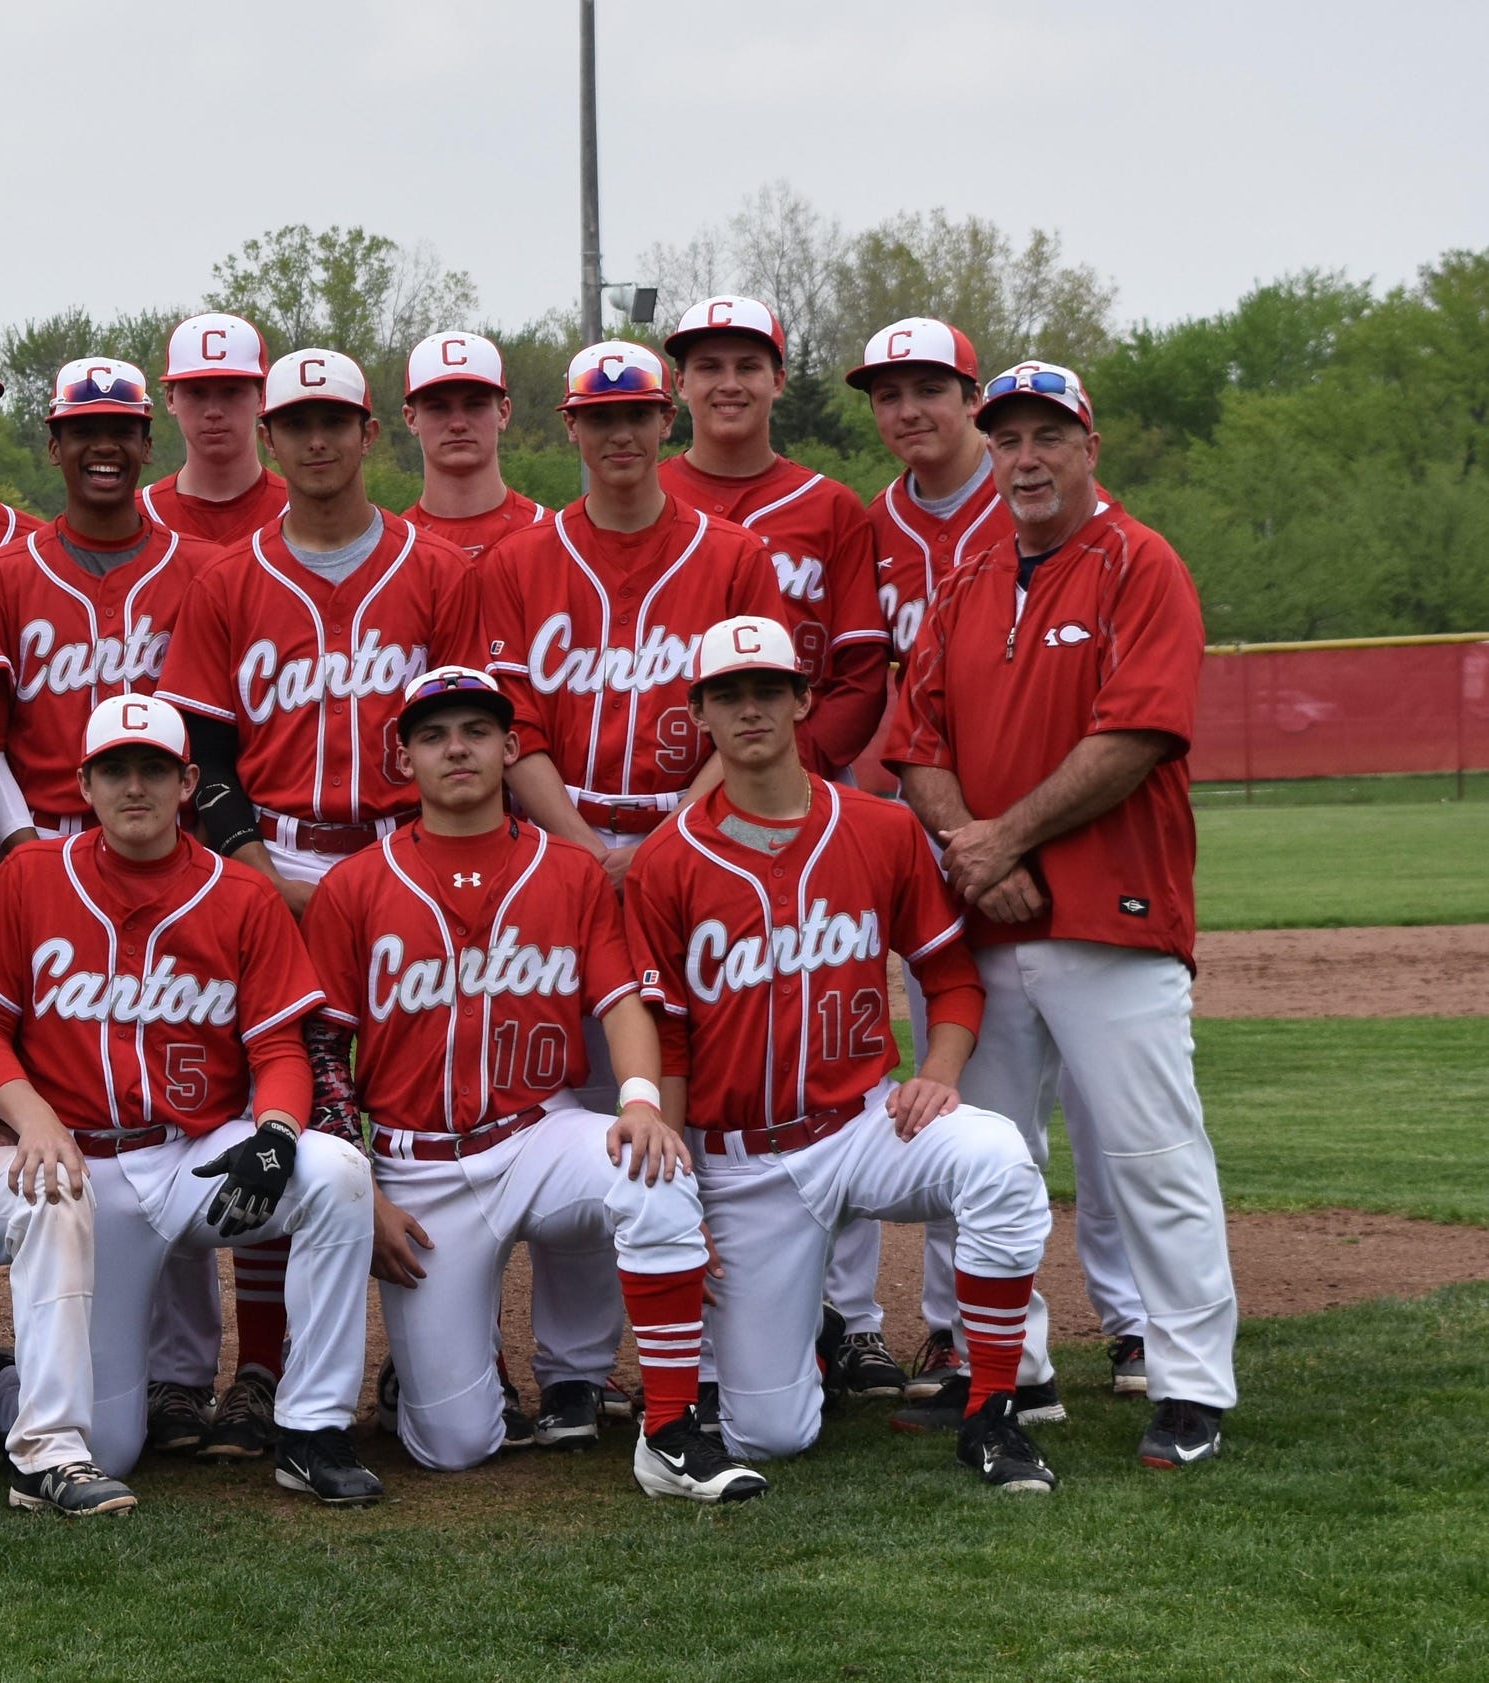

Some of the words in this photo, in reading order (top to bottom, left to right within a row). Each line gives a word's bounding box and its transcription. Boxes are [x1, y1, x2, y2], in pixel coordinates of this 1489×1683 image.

[201, 330, 227, 361] C
[708, 302, 732, 327] C
[887, 331, 911, 359] C
[300, 359, 326, 387] C
[442, 339, 467, 366] C
[17, 615, 172, 702] Canto
[732, 625, 760, 654] C
[122, 703, 148, 731] C
[655, 706, 701, 774] 9
[32, 937, 238, 1027] Canton
[368, 925, 580, 1023] Canton
[685, 898, 881, 1005] Canton
[493, 1020, 568, 1090] 10
[818, 988, 885, 1061] 12
[165, 1043, 208, 1111] 5
